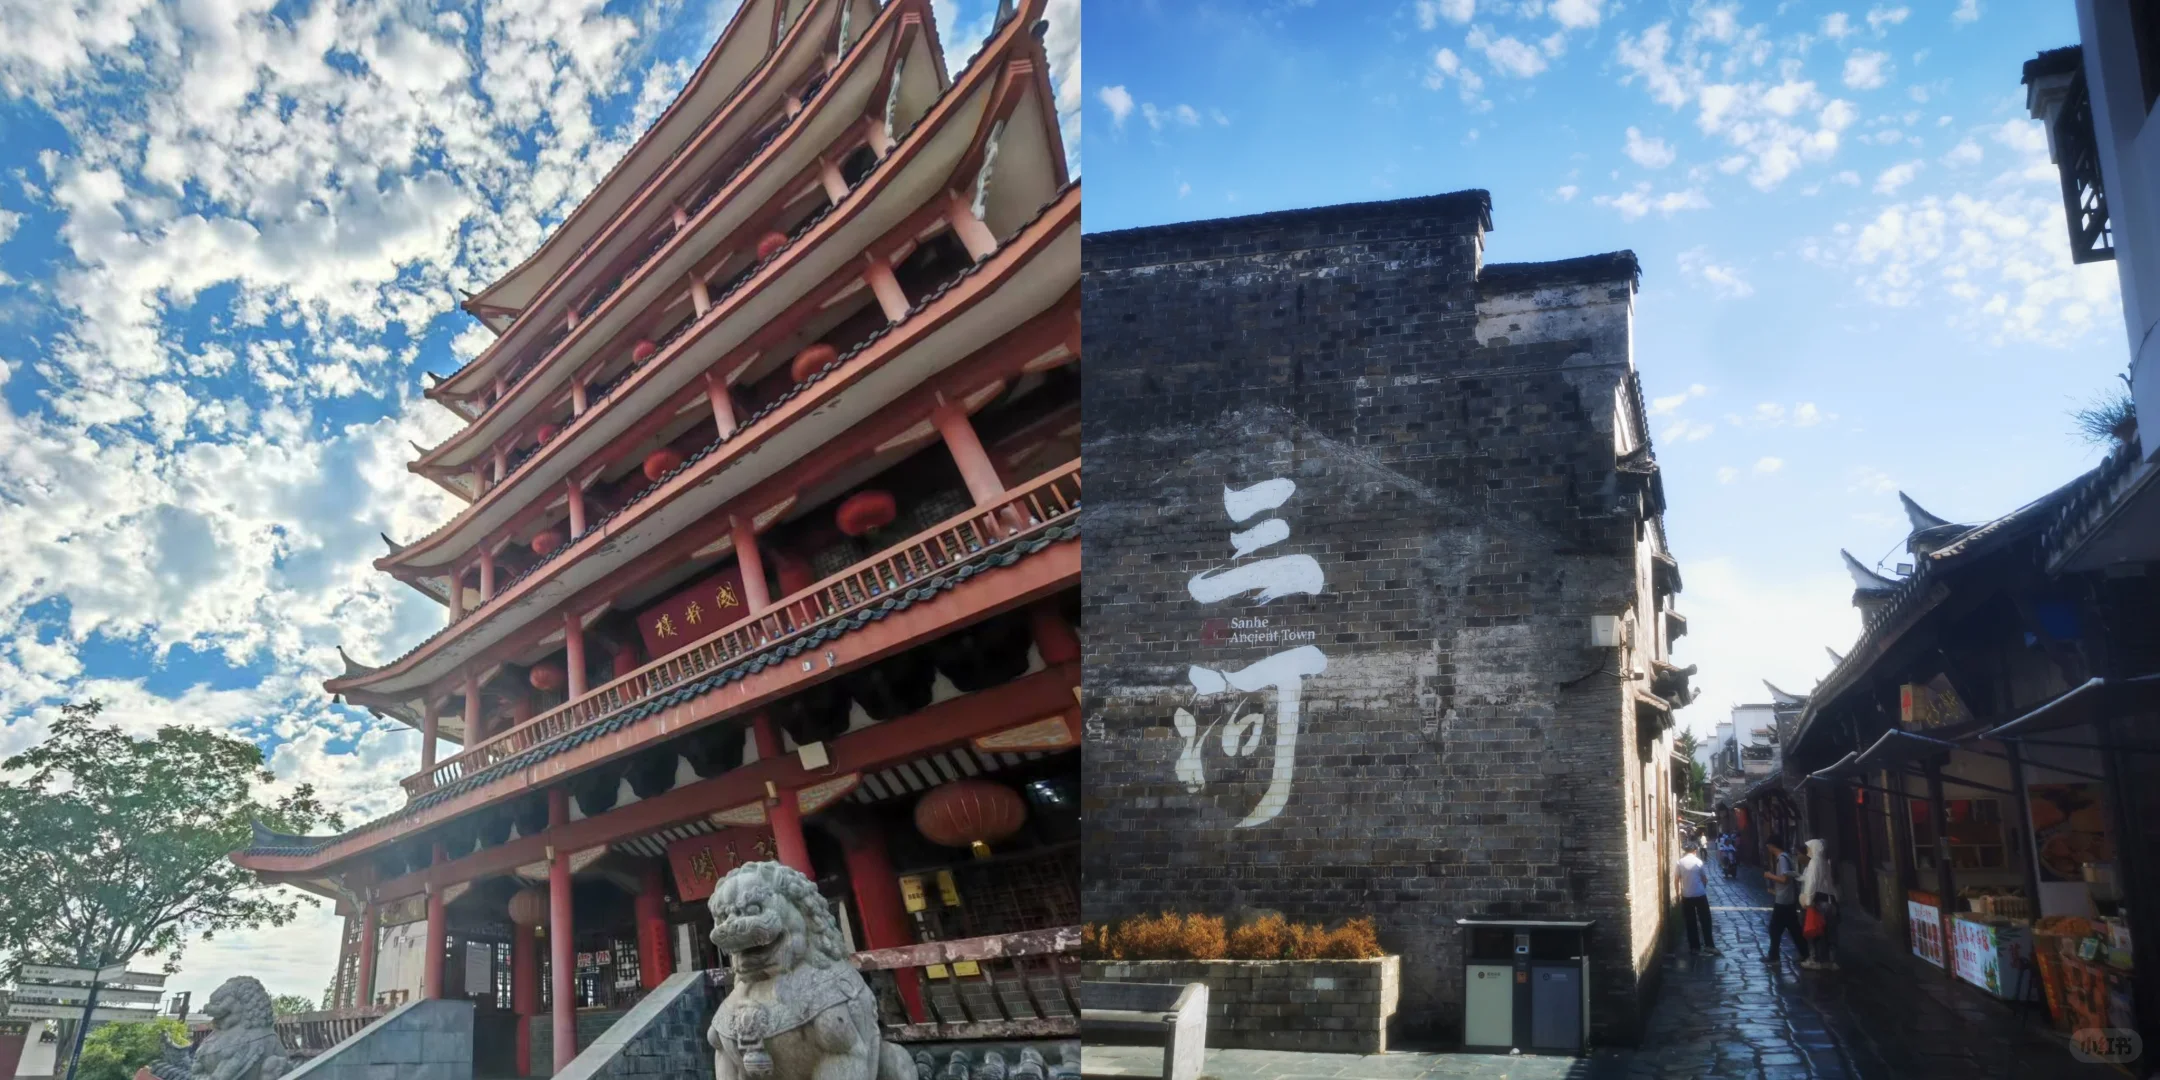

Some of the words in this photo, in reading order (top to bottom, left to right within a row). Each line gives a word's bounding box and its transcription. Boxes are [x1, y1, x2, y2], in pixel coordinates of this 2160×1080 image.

[1231, 616, 1269, 629] Sanhe
[1230, 630, 1279, 643] Ancient
[1281, 629, 1316, 641] Town
[1174, 478, 1328, 828] 三河
